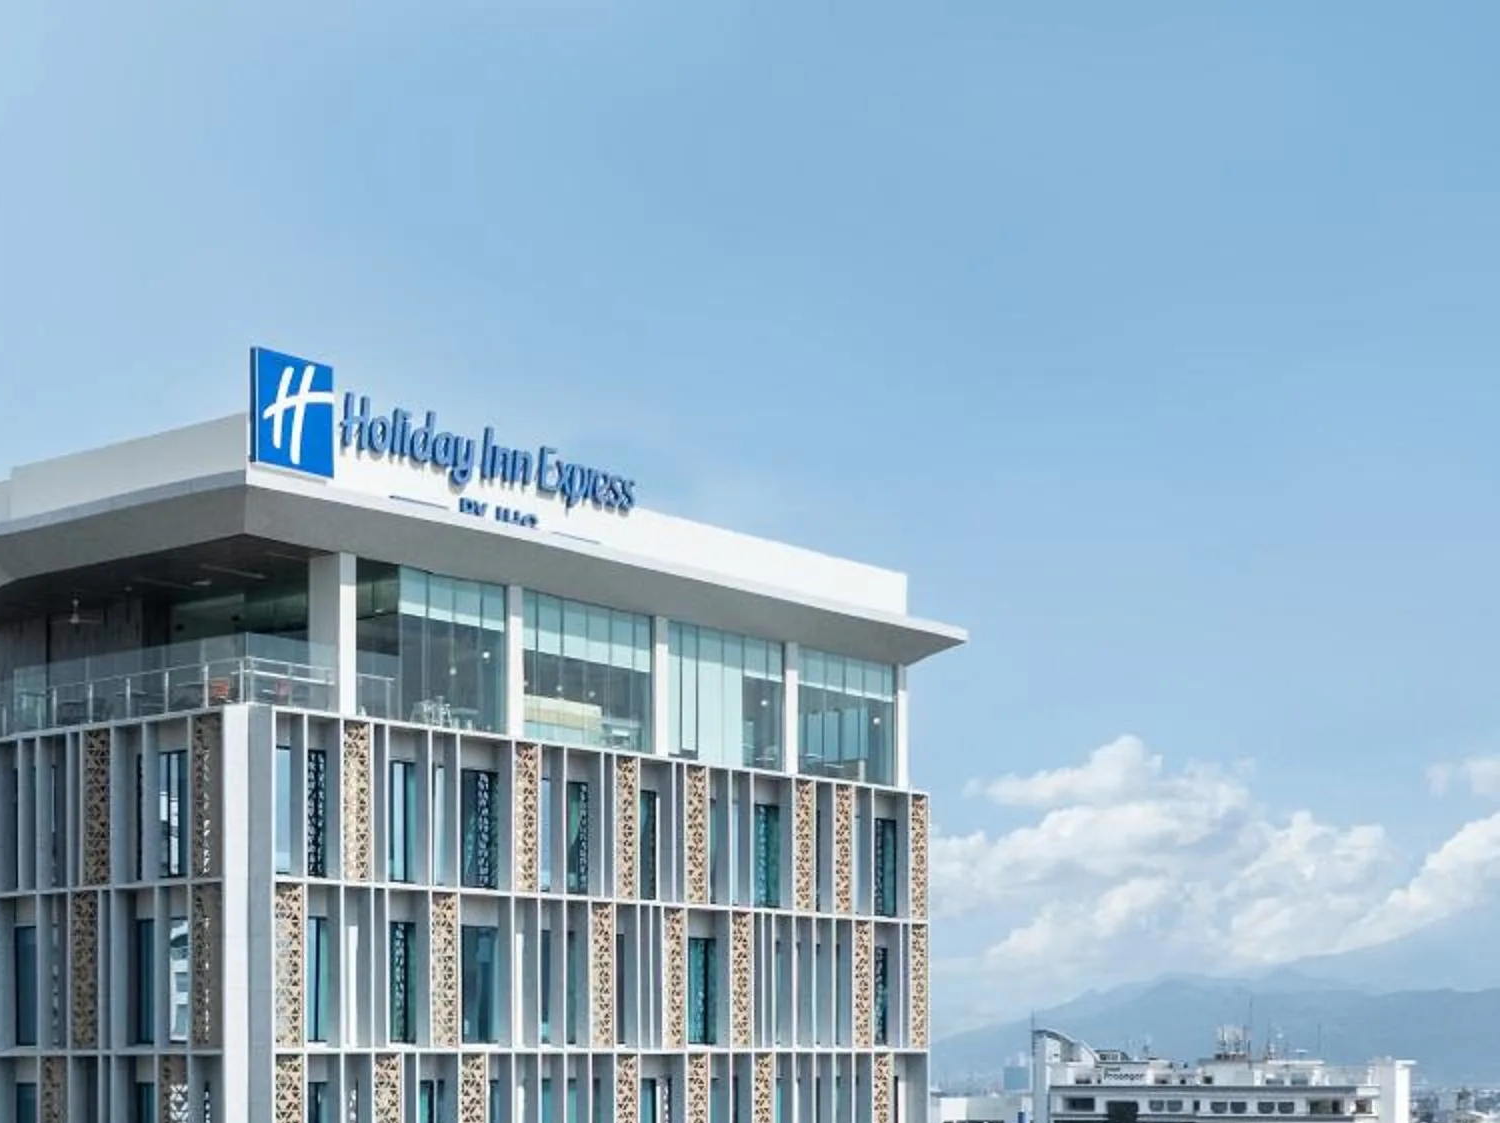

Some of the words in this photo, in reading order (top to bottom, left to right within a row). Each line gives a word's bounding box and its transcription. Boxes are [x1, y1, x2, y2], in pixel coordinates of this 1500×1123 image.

[340, 391, 474, 486] Holiday
[481, 426, 532, 485] Inn
[537, 445, 635, 509] Express
